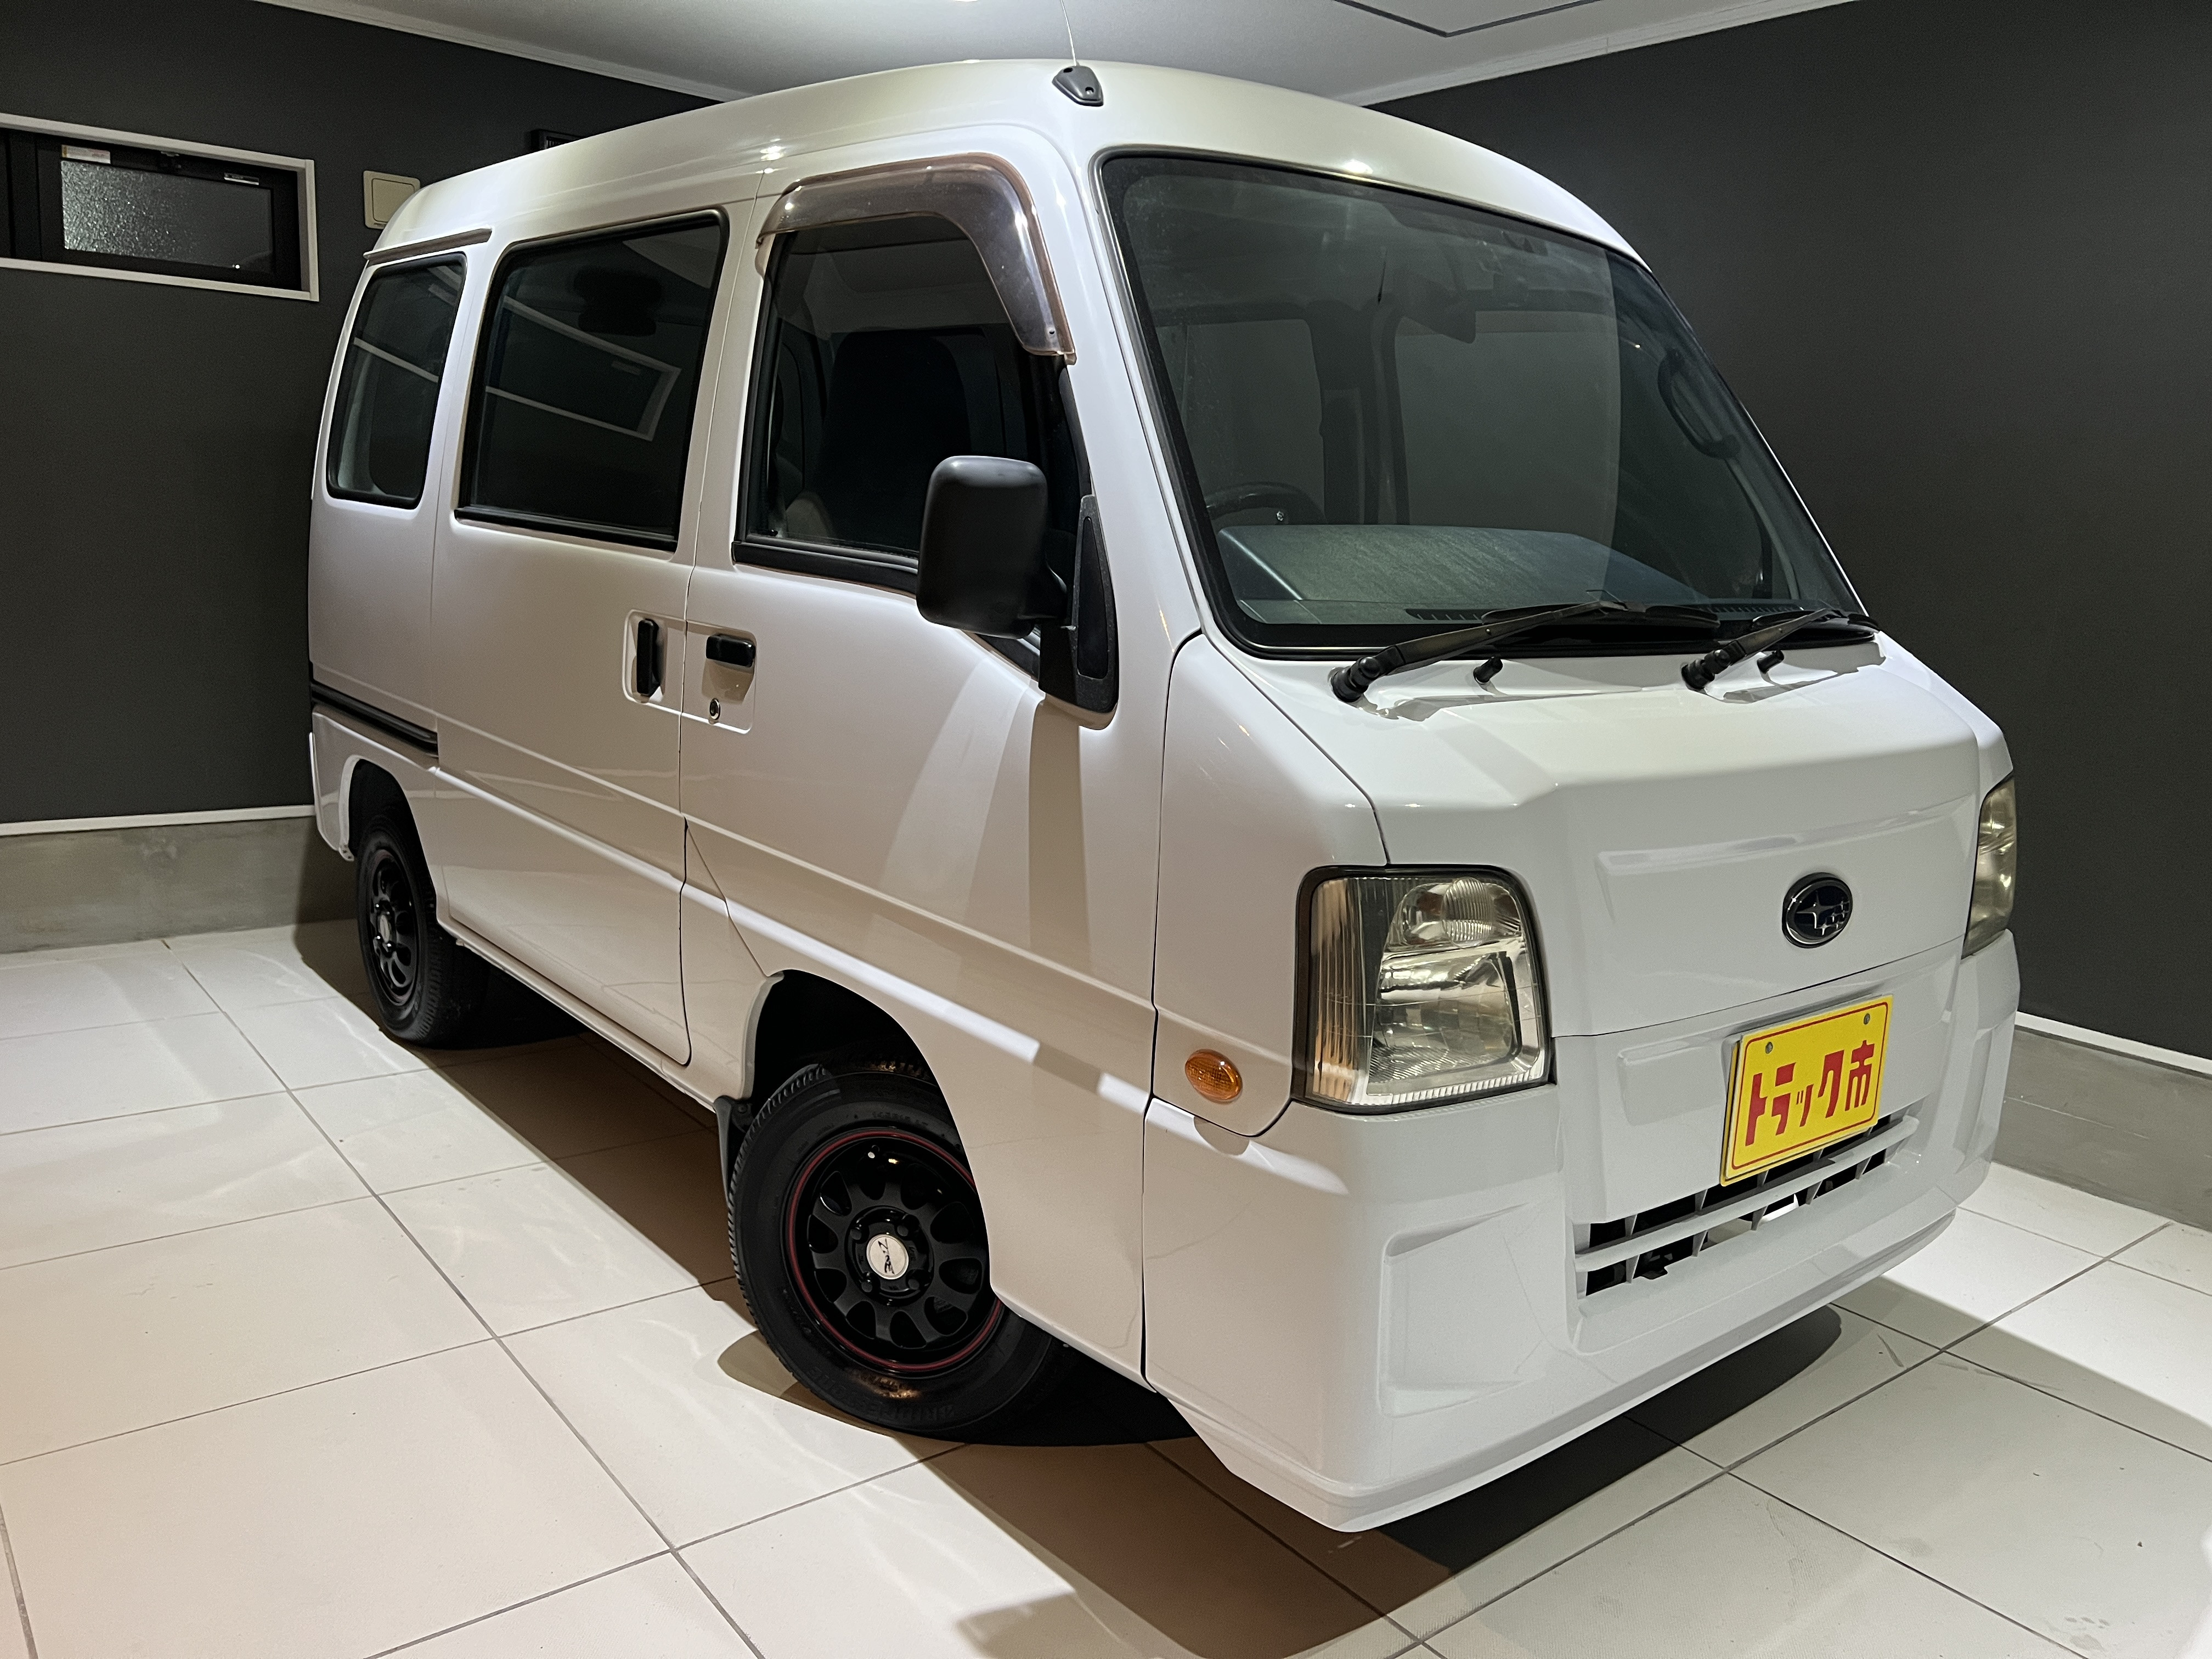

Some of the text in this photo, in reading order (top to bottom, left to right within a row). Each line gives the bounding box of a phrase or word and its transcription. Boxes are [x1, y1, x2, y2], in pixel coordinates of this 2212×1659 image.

[1745, 1040, 1875, 1147] トラック市
